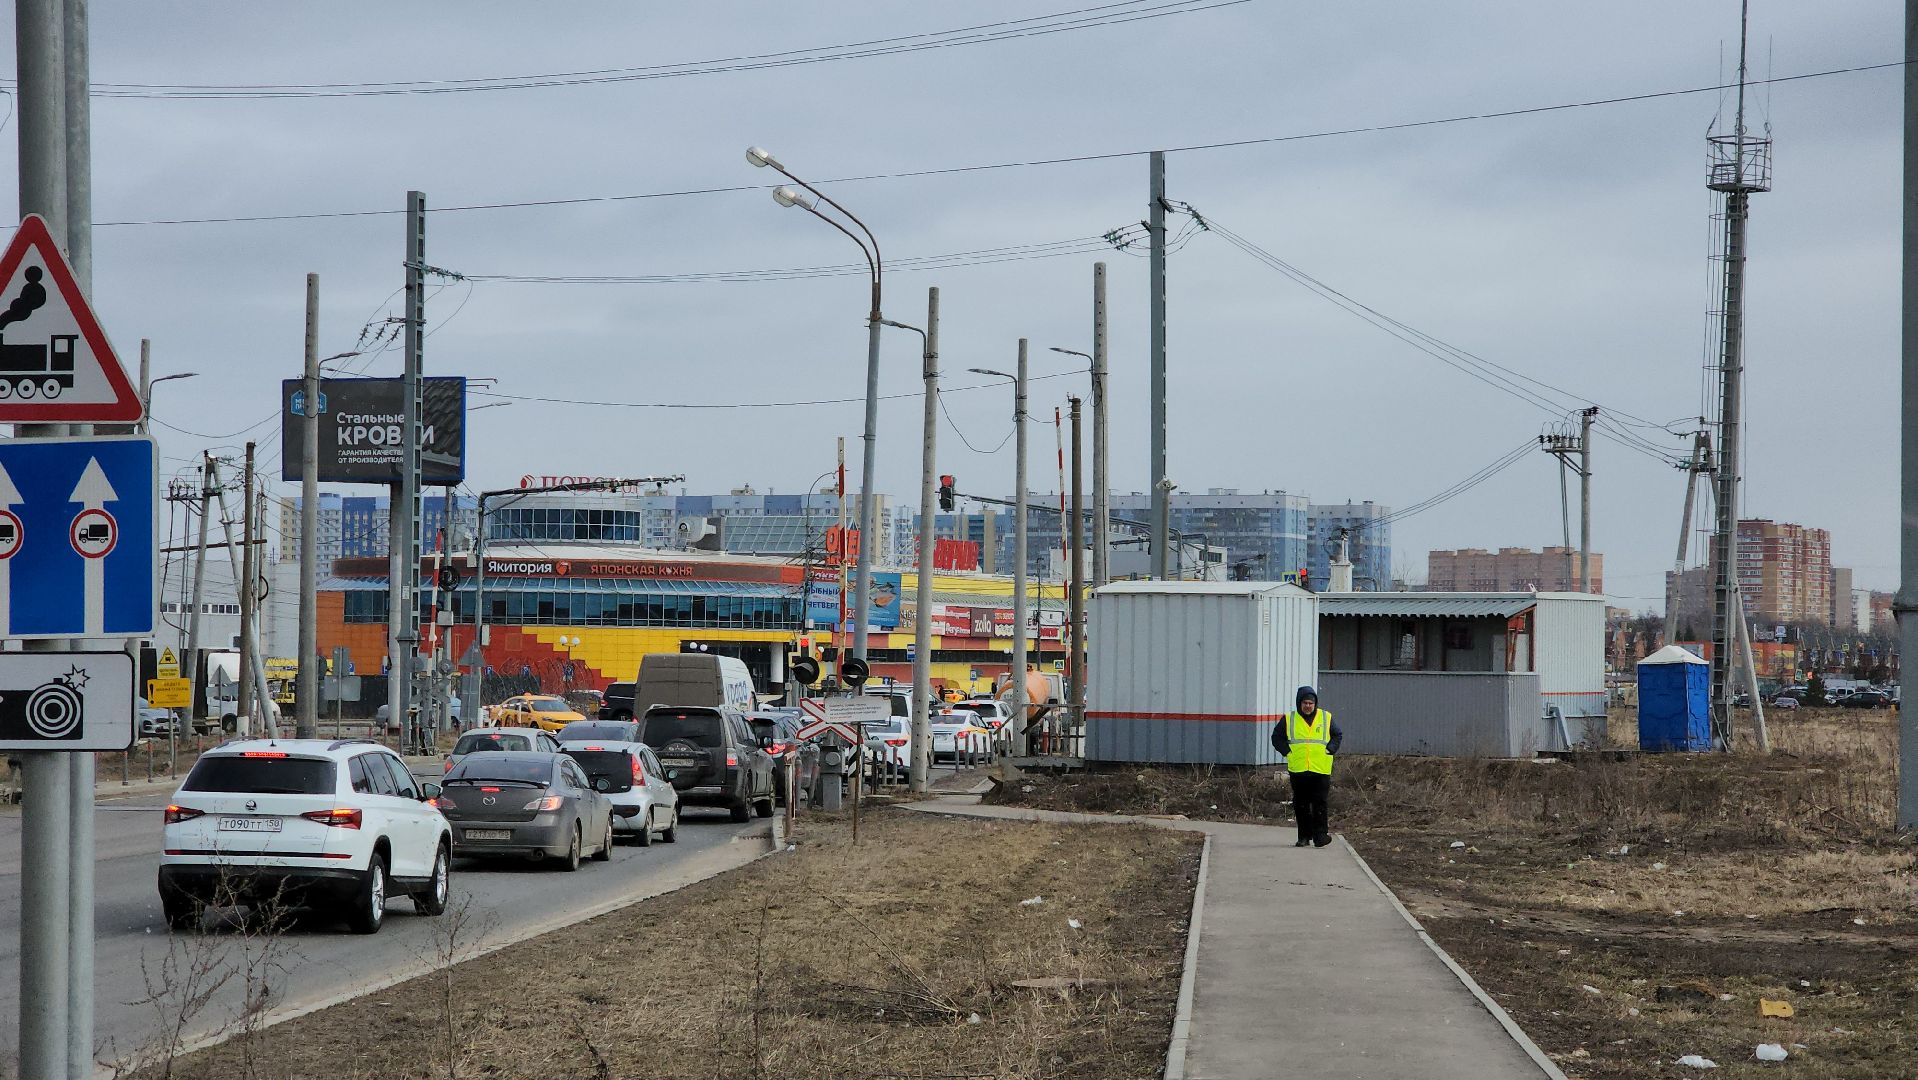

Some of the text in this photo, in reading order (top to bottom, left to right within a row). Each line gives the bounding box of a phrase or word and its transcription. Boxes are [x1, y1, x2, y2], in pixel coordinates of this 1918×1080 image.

[336, 411, 405, 424] Стальные
[337, 425, 435, 446] КРОВИ
[488, 561, 552, 575] Якитория
[591, 564, 655, 575] ЯПОНСКАЯ
